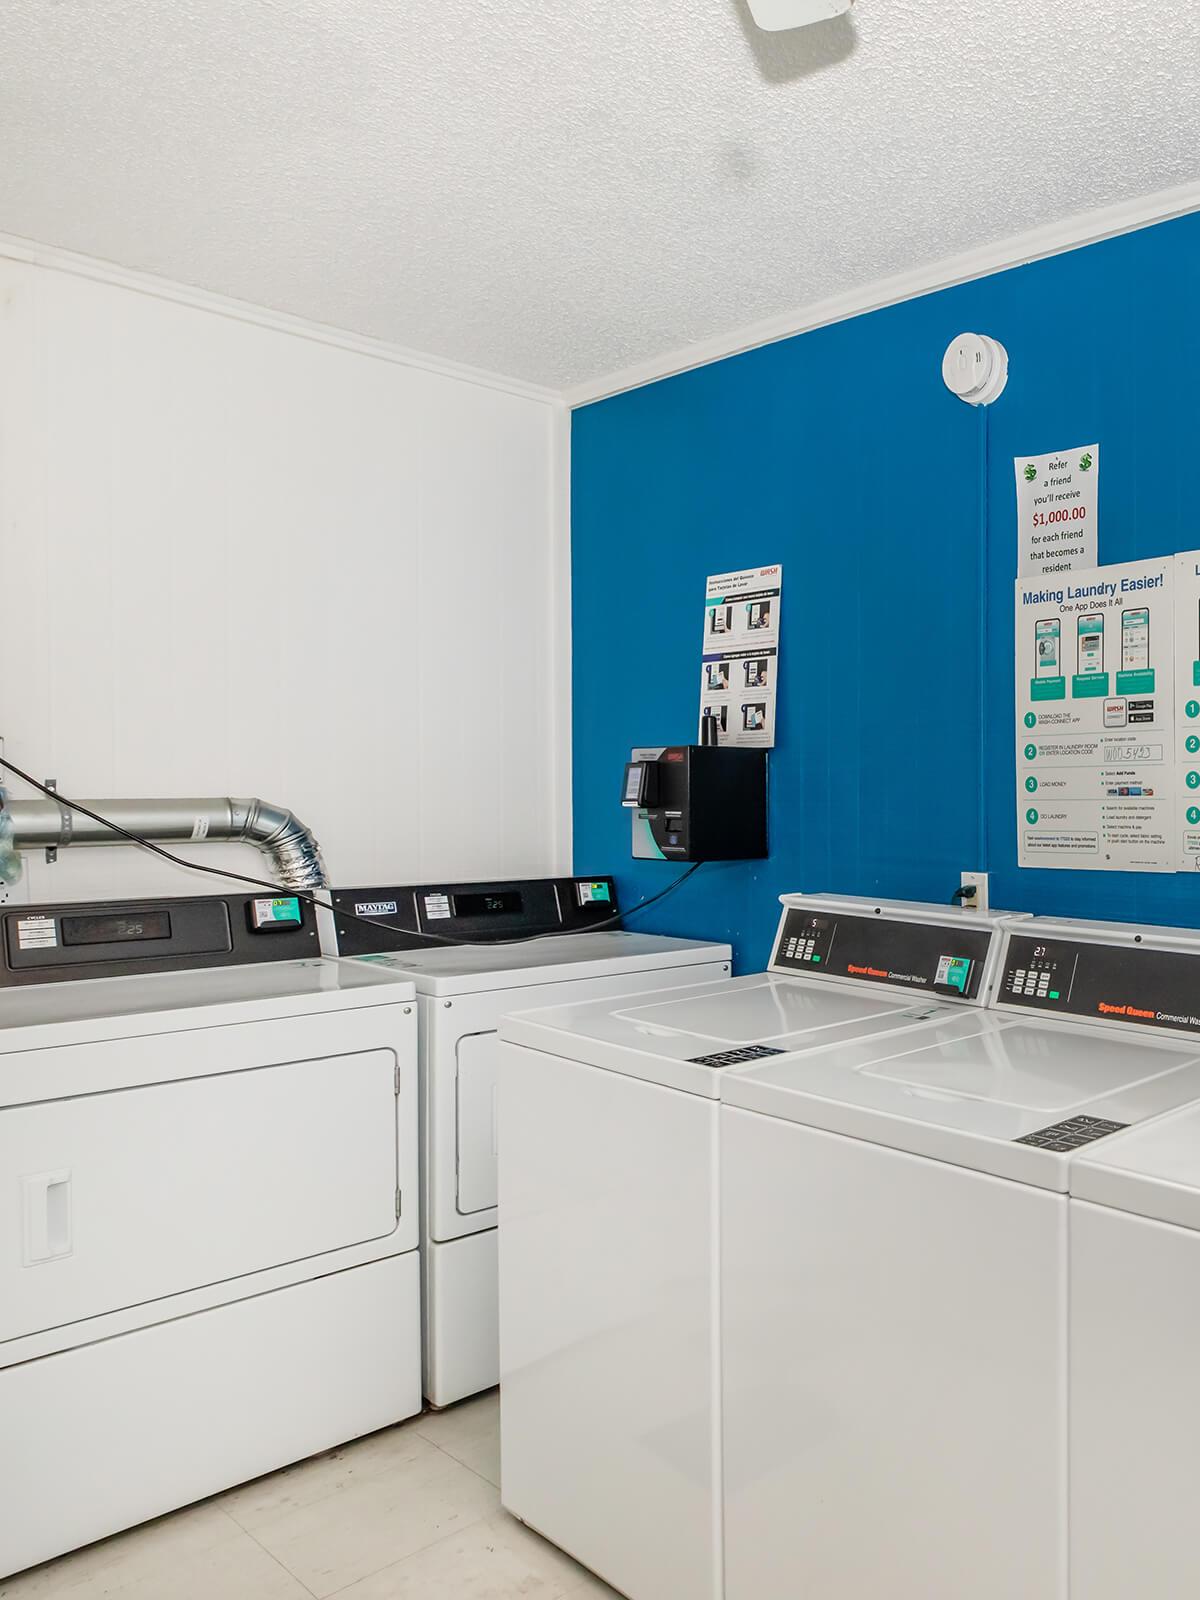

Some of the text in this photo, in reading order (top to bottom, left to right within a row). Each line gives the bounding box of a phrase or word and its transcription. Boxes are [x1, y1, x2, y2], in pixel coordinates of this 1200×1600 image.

[1048, 460, 1068, 471] Refer
[1050, 475, 1072, 486] friend
[1055, 490, 1080, 502] receive
[1032, 506, 1086, 528] $1,000.00
[1031, 529, 1083, 544] for each friend
[1030, 552, 1044, 560] that
[1046, 548, 1078, 558] becomes
[1042, 563, 1071, 573] resident
[1023, 573, 1163, 605] Making Laundry Easier!
[1060, 604, 1073, 612] One
[1075, 604, 1088, 612] App
[1090, 600, 1107, 609] Does
[1114, 598, 1123, 606] All
[1190, 704, 1195, 713] 1
[1028, 716, 1032, 724] 1
[1190, 740, 1195, 748] 2
[1028, 748, 1033, 756] 2
[1029, 780, 1034, 788] 3
[1190, 775, 1196, 784] 3
[1030, 812, 1035, 820] 4
[1191, 810, 1196, 819] 4
[358, 903, 394, 912] MAYTAG
[1034, 946, 1045, 956] 27
[888, 971, 911, 981] Commercial
[912, 975, 927, 984] Washer
[1098, 1002, 1125, 1016] Speed
[1127, 1006, 1155, 1019] Queen
[1156, 1012, 1188, 1024] Commercial
